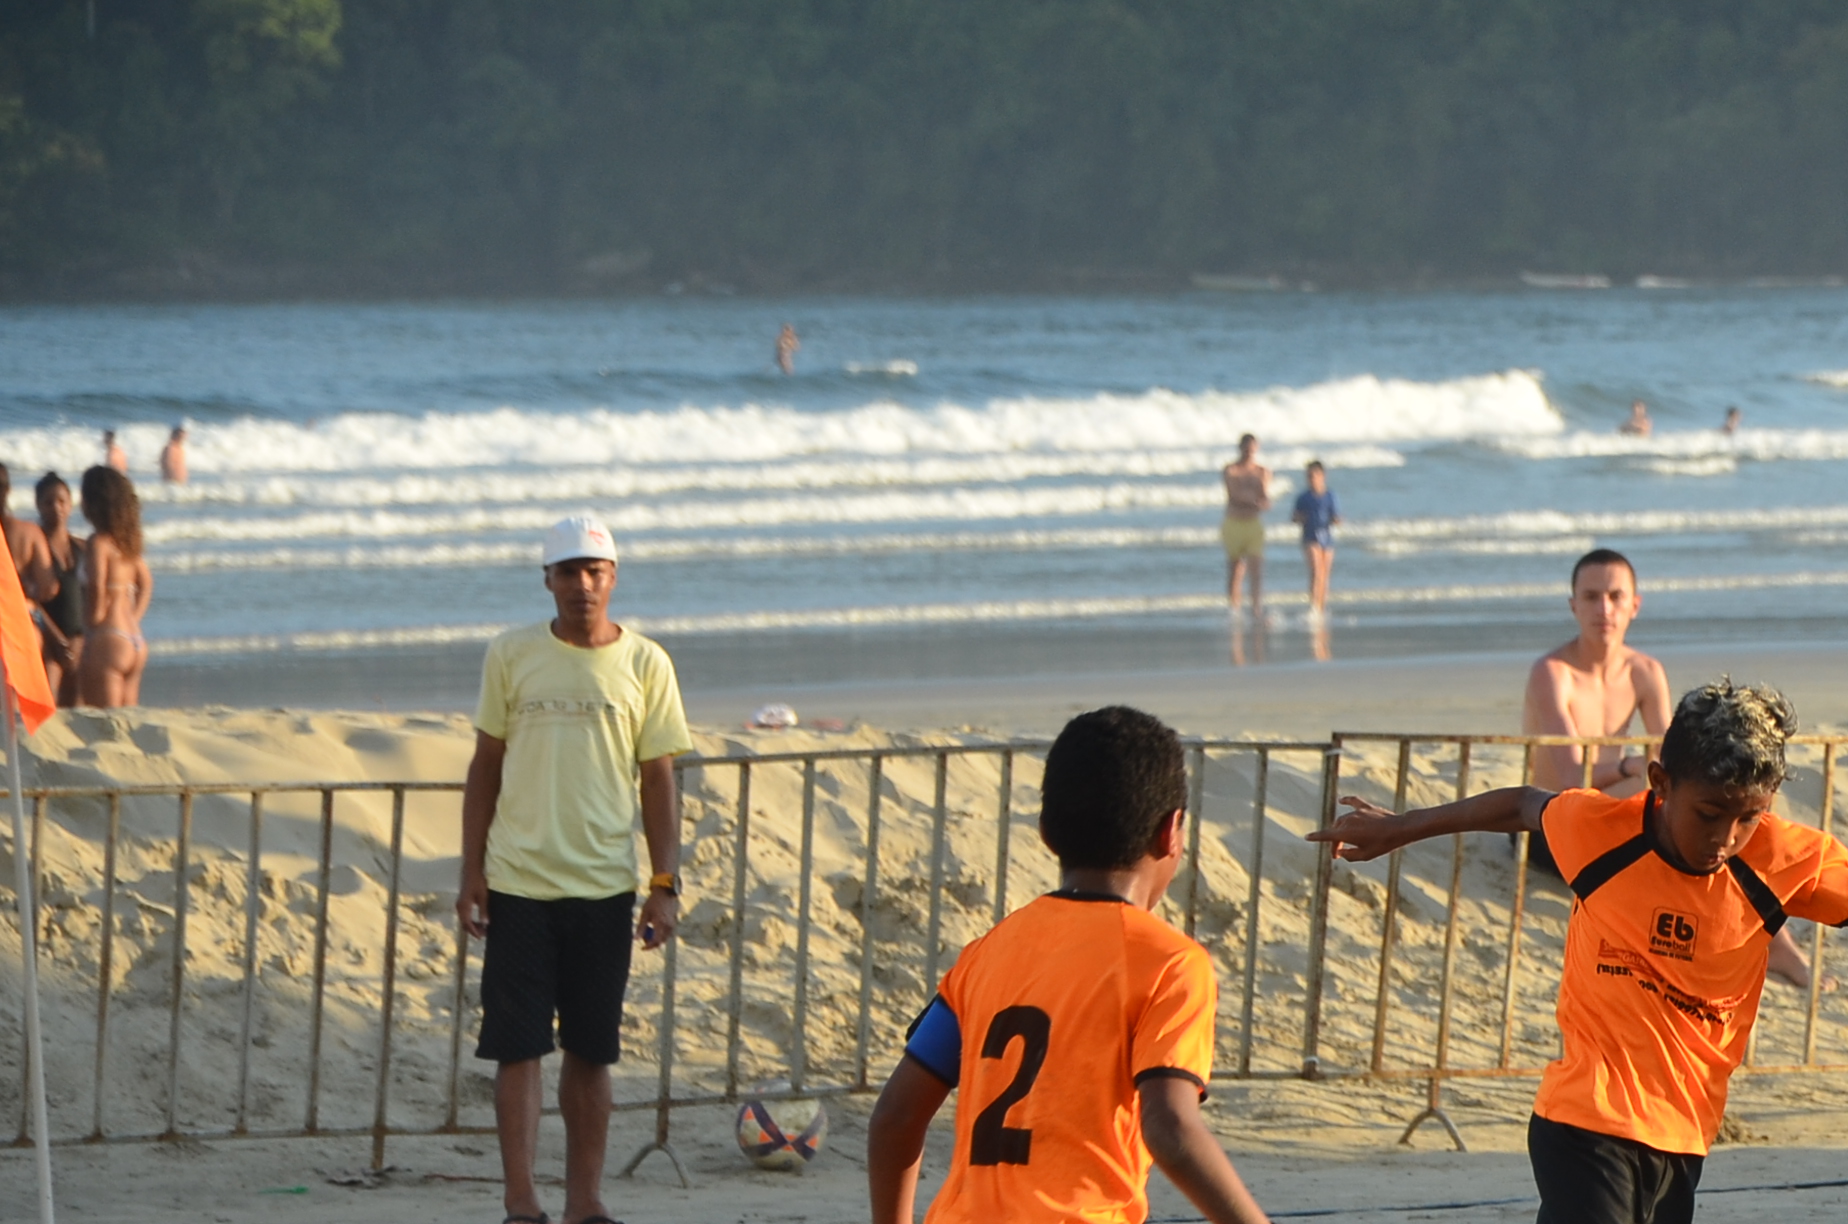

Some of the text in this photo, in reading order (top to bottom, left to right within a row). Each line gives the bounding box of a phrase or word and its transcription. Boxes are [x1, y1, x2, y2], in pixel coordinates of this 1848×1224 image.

[1657, 912, 1694, 942] Eb
[1651, 935, 1692, 951] Euroball
[970, 1005, 1052, 1166] 2
